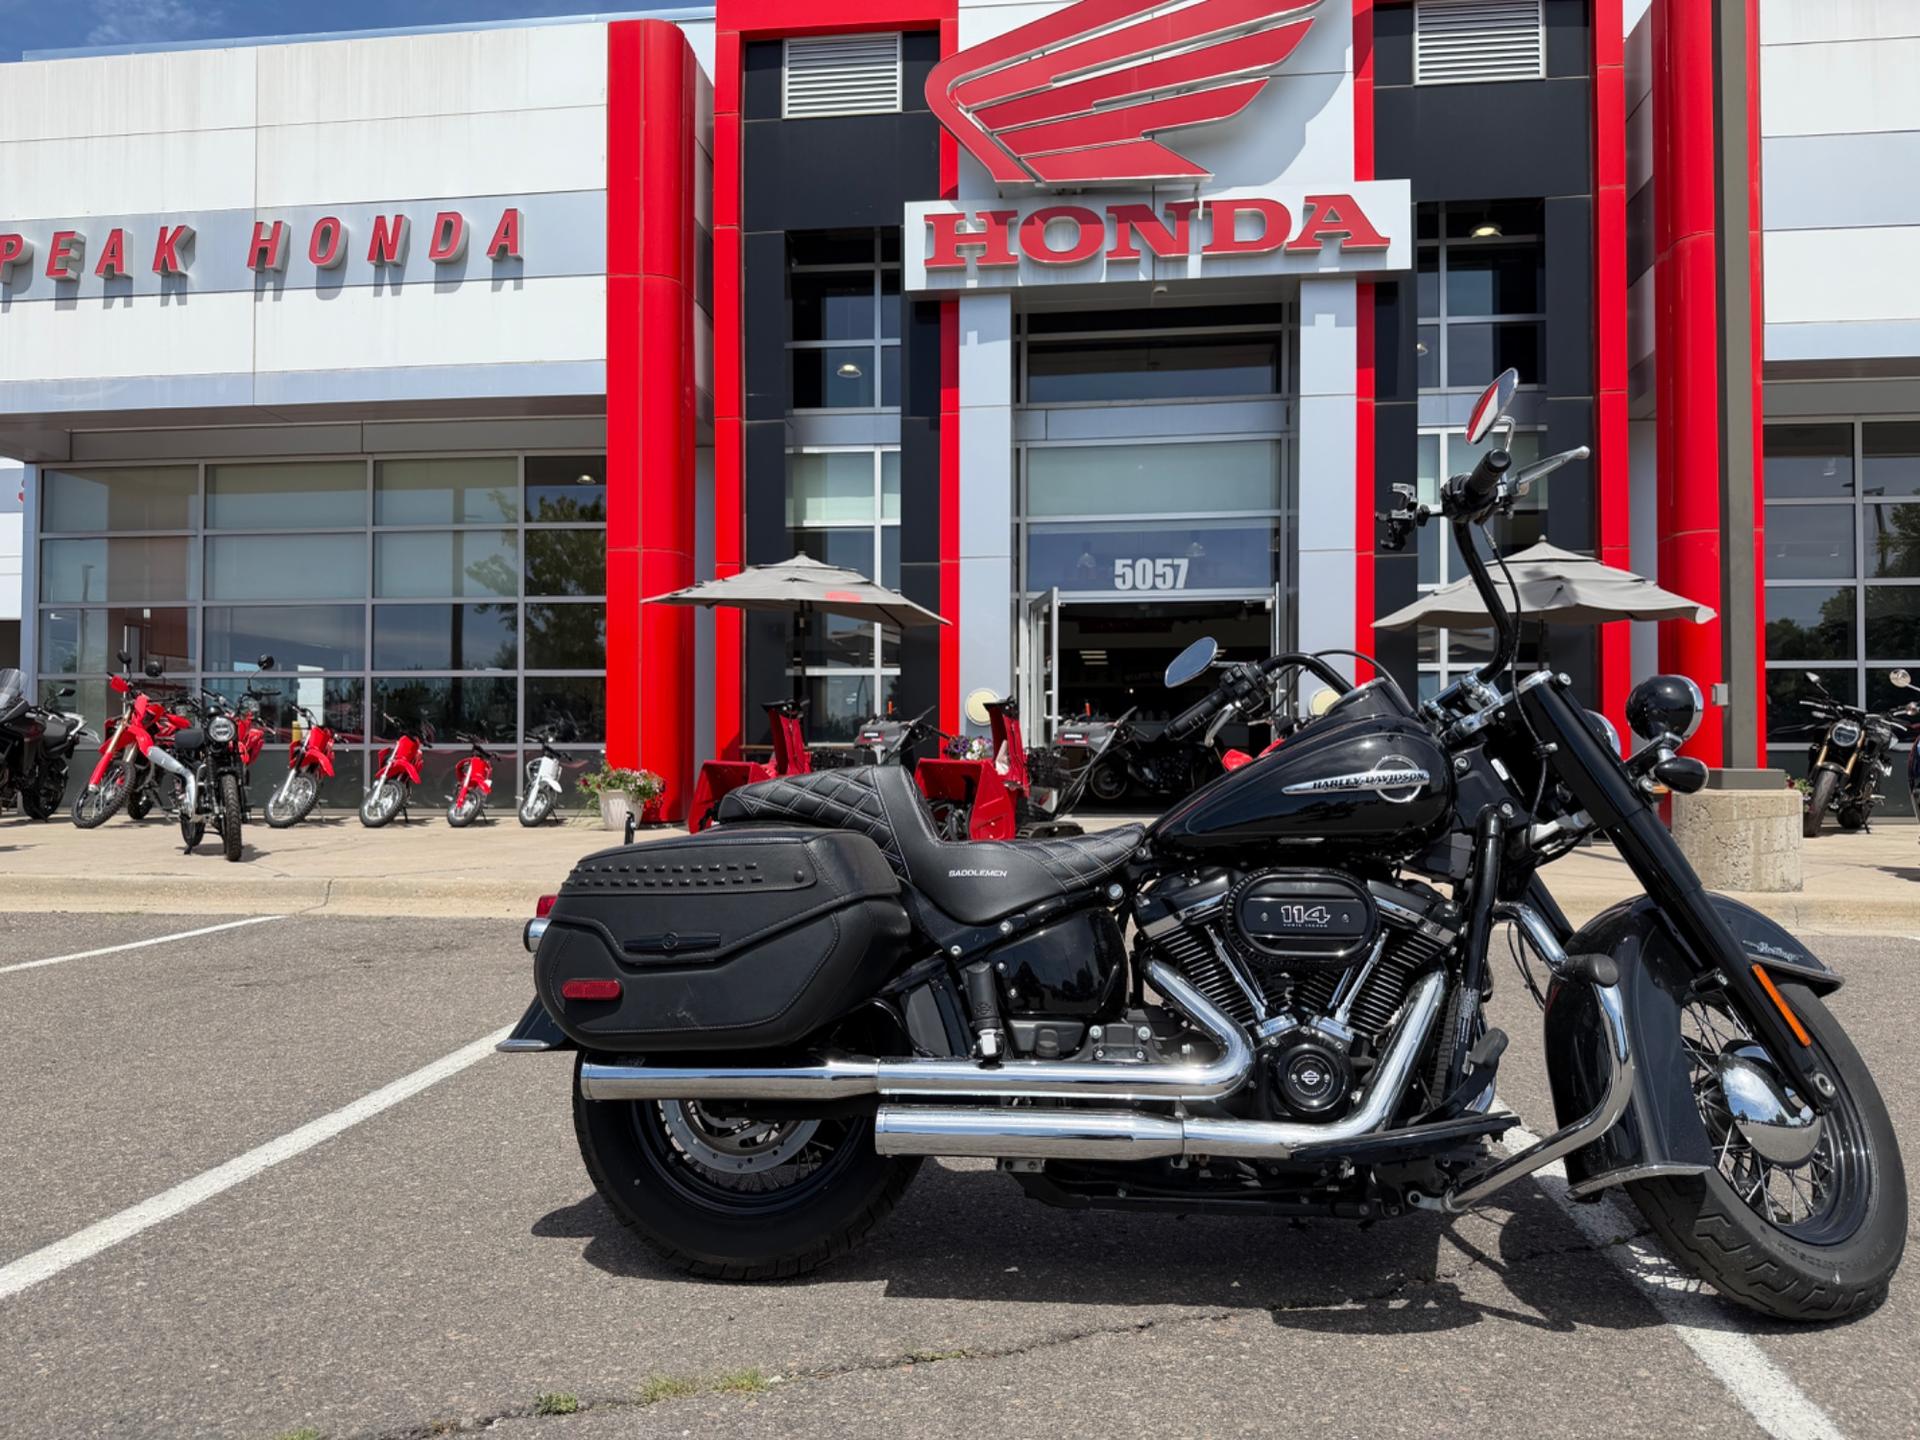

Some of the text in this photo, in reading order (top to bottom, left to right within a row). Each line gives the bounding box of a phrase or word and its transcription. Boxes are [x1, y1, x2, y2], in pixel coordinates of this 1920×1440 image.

[923, 194, 1391, 268] HONDA
[0, 208, 521, 282] PEAK HONDA
[1114, 558, 1189, 590] 5057
[1311, 772, 1427, 790] HARLEY-DAVIDSON
[948, 868, 1008, 878] SADDLEMEN
[1280, 905, 1331, 924] 114
